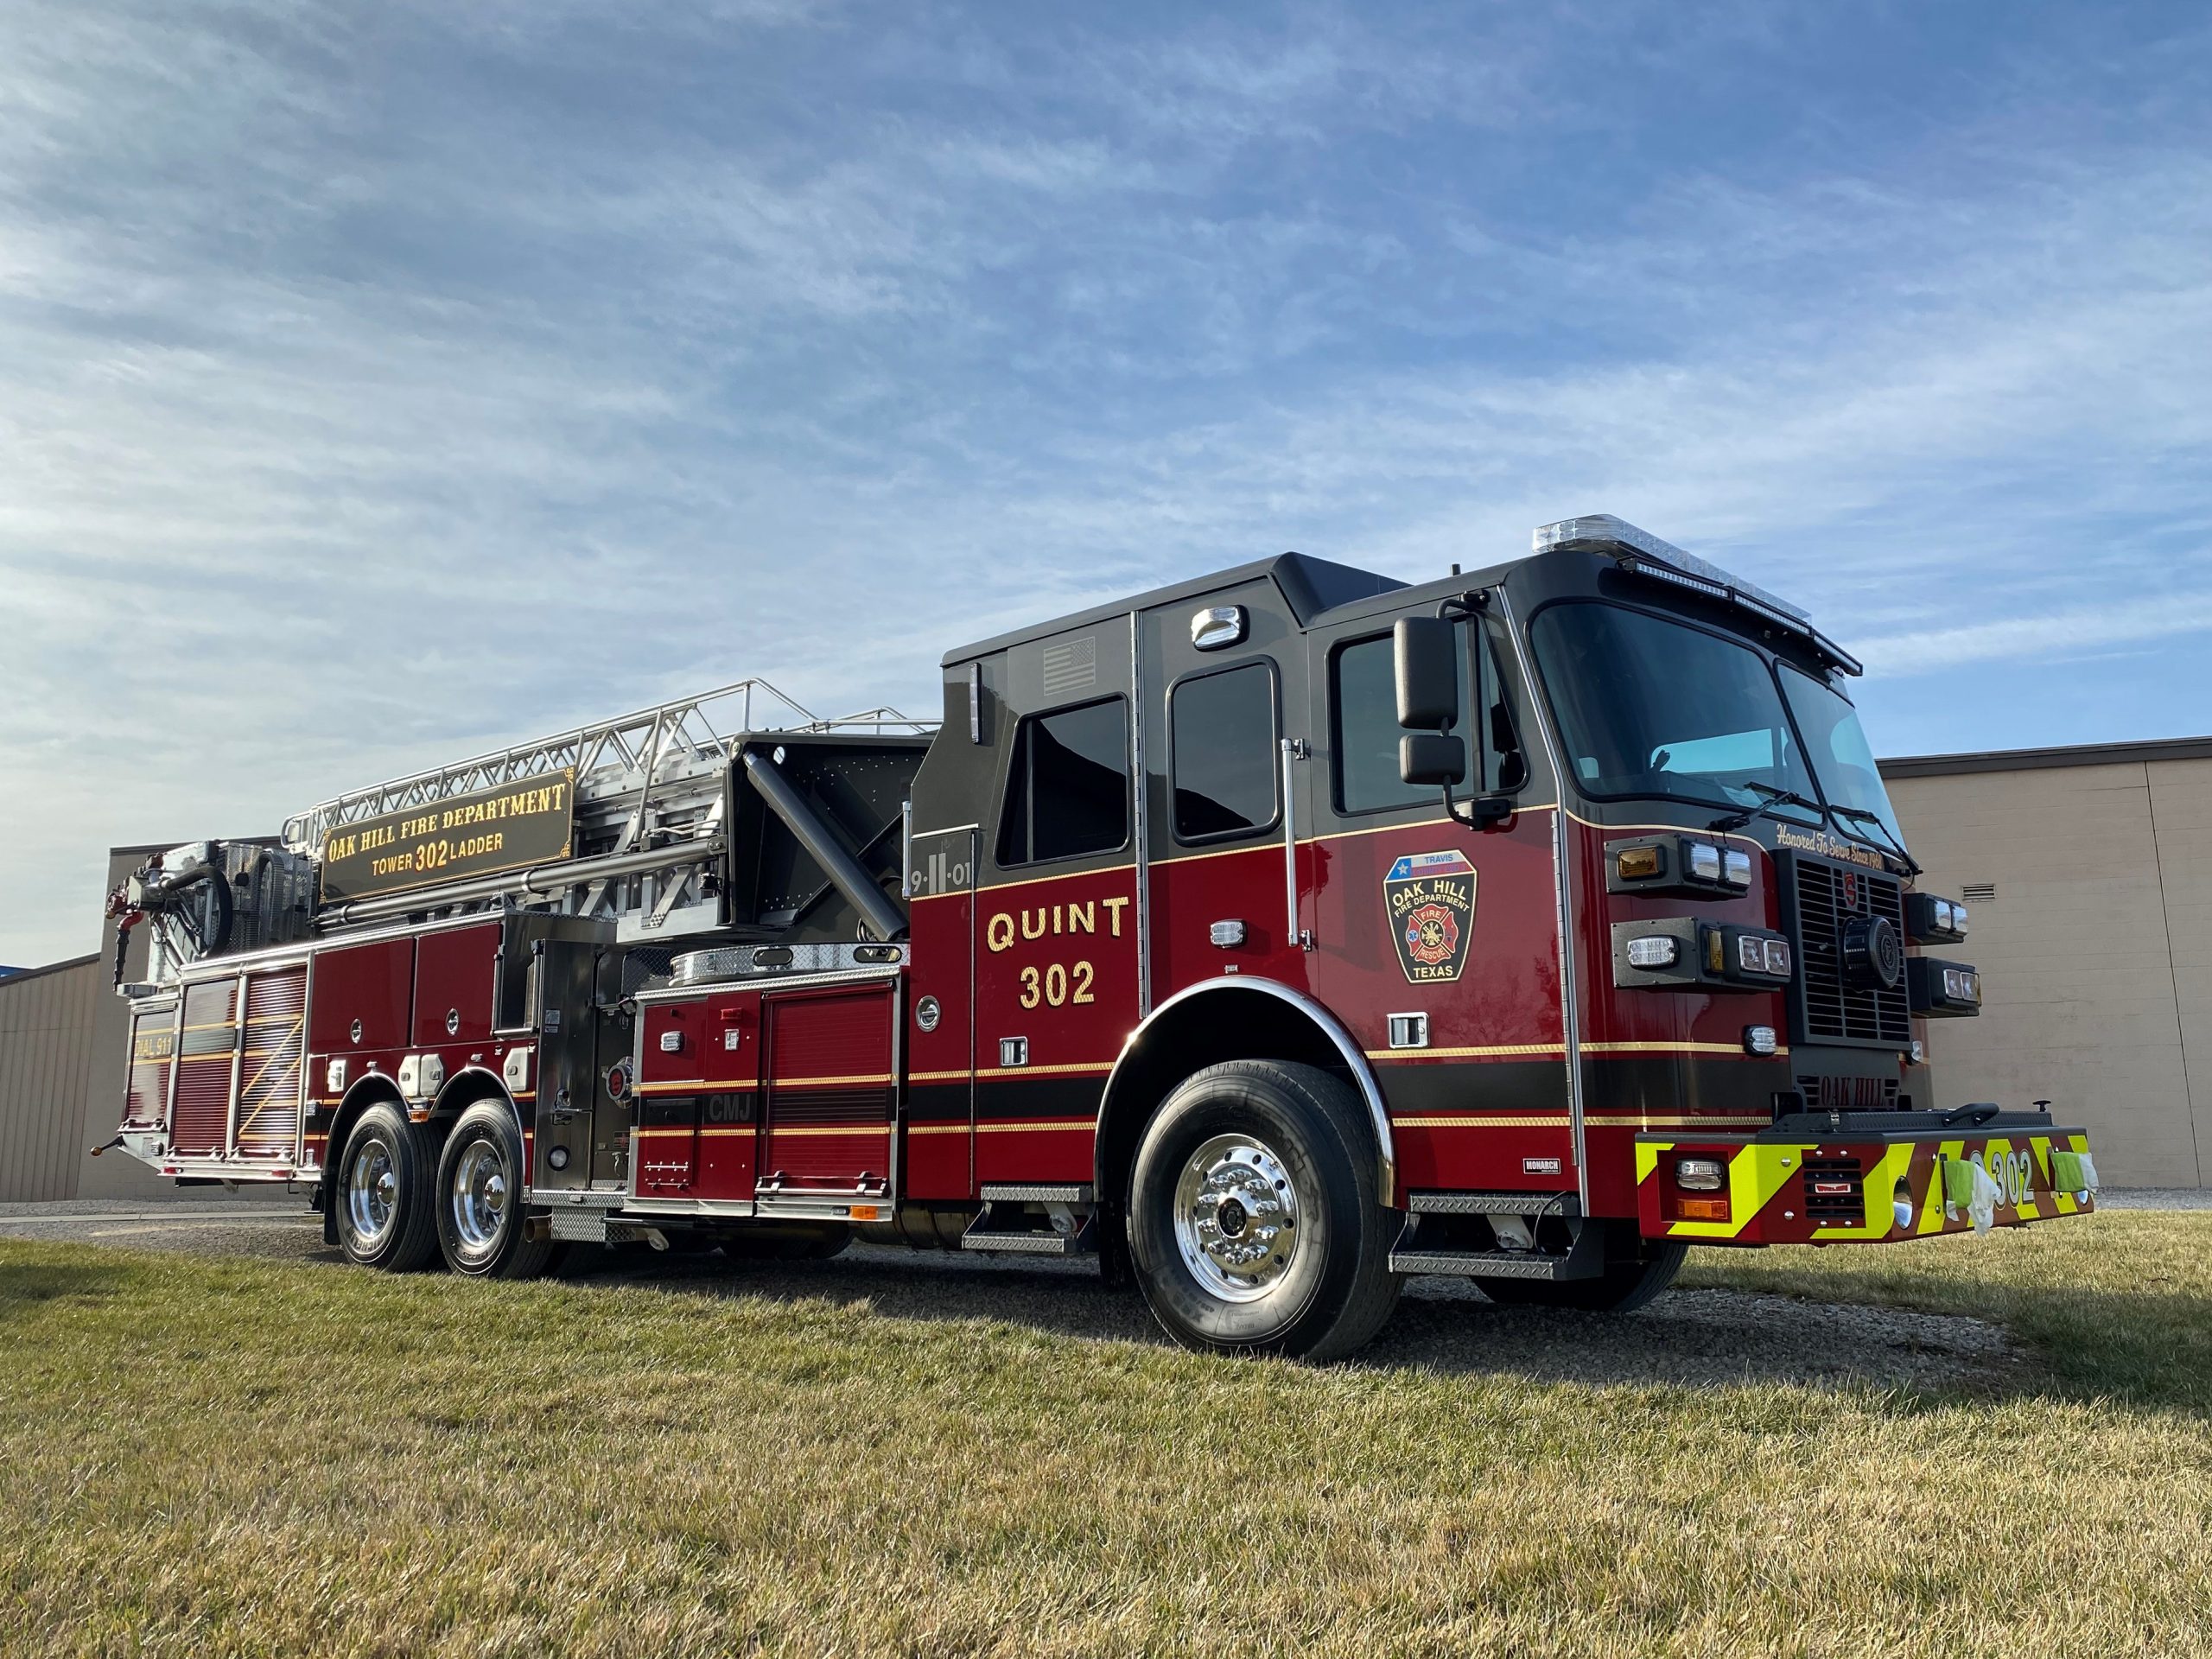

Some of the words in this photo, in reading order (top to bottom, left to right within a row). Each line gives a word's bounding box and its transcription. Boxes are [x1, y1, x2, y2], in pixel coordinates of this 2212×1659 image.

[328, 835, 356, 863] OAK
[360, 828, 396, 852] HILL
[400, 813, 437, 840] FIRE
[442, 783, 566, 830] DEPARTMENT
[372, 852, 413, 876] TOWER
[415, 839, 448, 872] 302
[449, 832, 503, 860] LADDER
[1776, 823, 1816, 851] Honored
[1816, 831, 1829, 854] To
[1829, 836, 1851, 861] Serve
[1851, 842, 1870, 865] Since
[1424, 854, 1453, 864] TRAVIS
[1392, 881, 1424, 907] OAK
[1433, 880, 1466, 900] HILL
[1394, 901, 1413, 918] FIRE
[1414, 894, 1470, 912] DEPARTMENT
[987, 896, 1129, 952] QUINT
[1421, 910, 1441, 920] FIRE
[1420, 948, 1446, 960] RESCUE
[1020, 960, 1095, 1009] 302
[1414, 965, 1453, 978] TEXAS
[156, 1037, 172, 1055] 911
[1821, 1075, 1851, 1106] OAK
[1854, 1077, 1884, 1107] HILL
[709, 1094, 751, 1122] CMJ
[1526, 1160, 1559, 1170] MONARCH
[1992, 1148, 2035, 1211] 302
